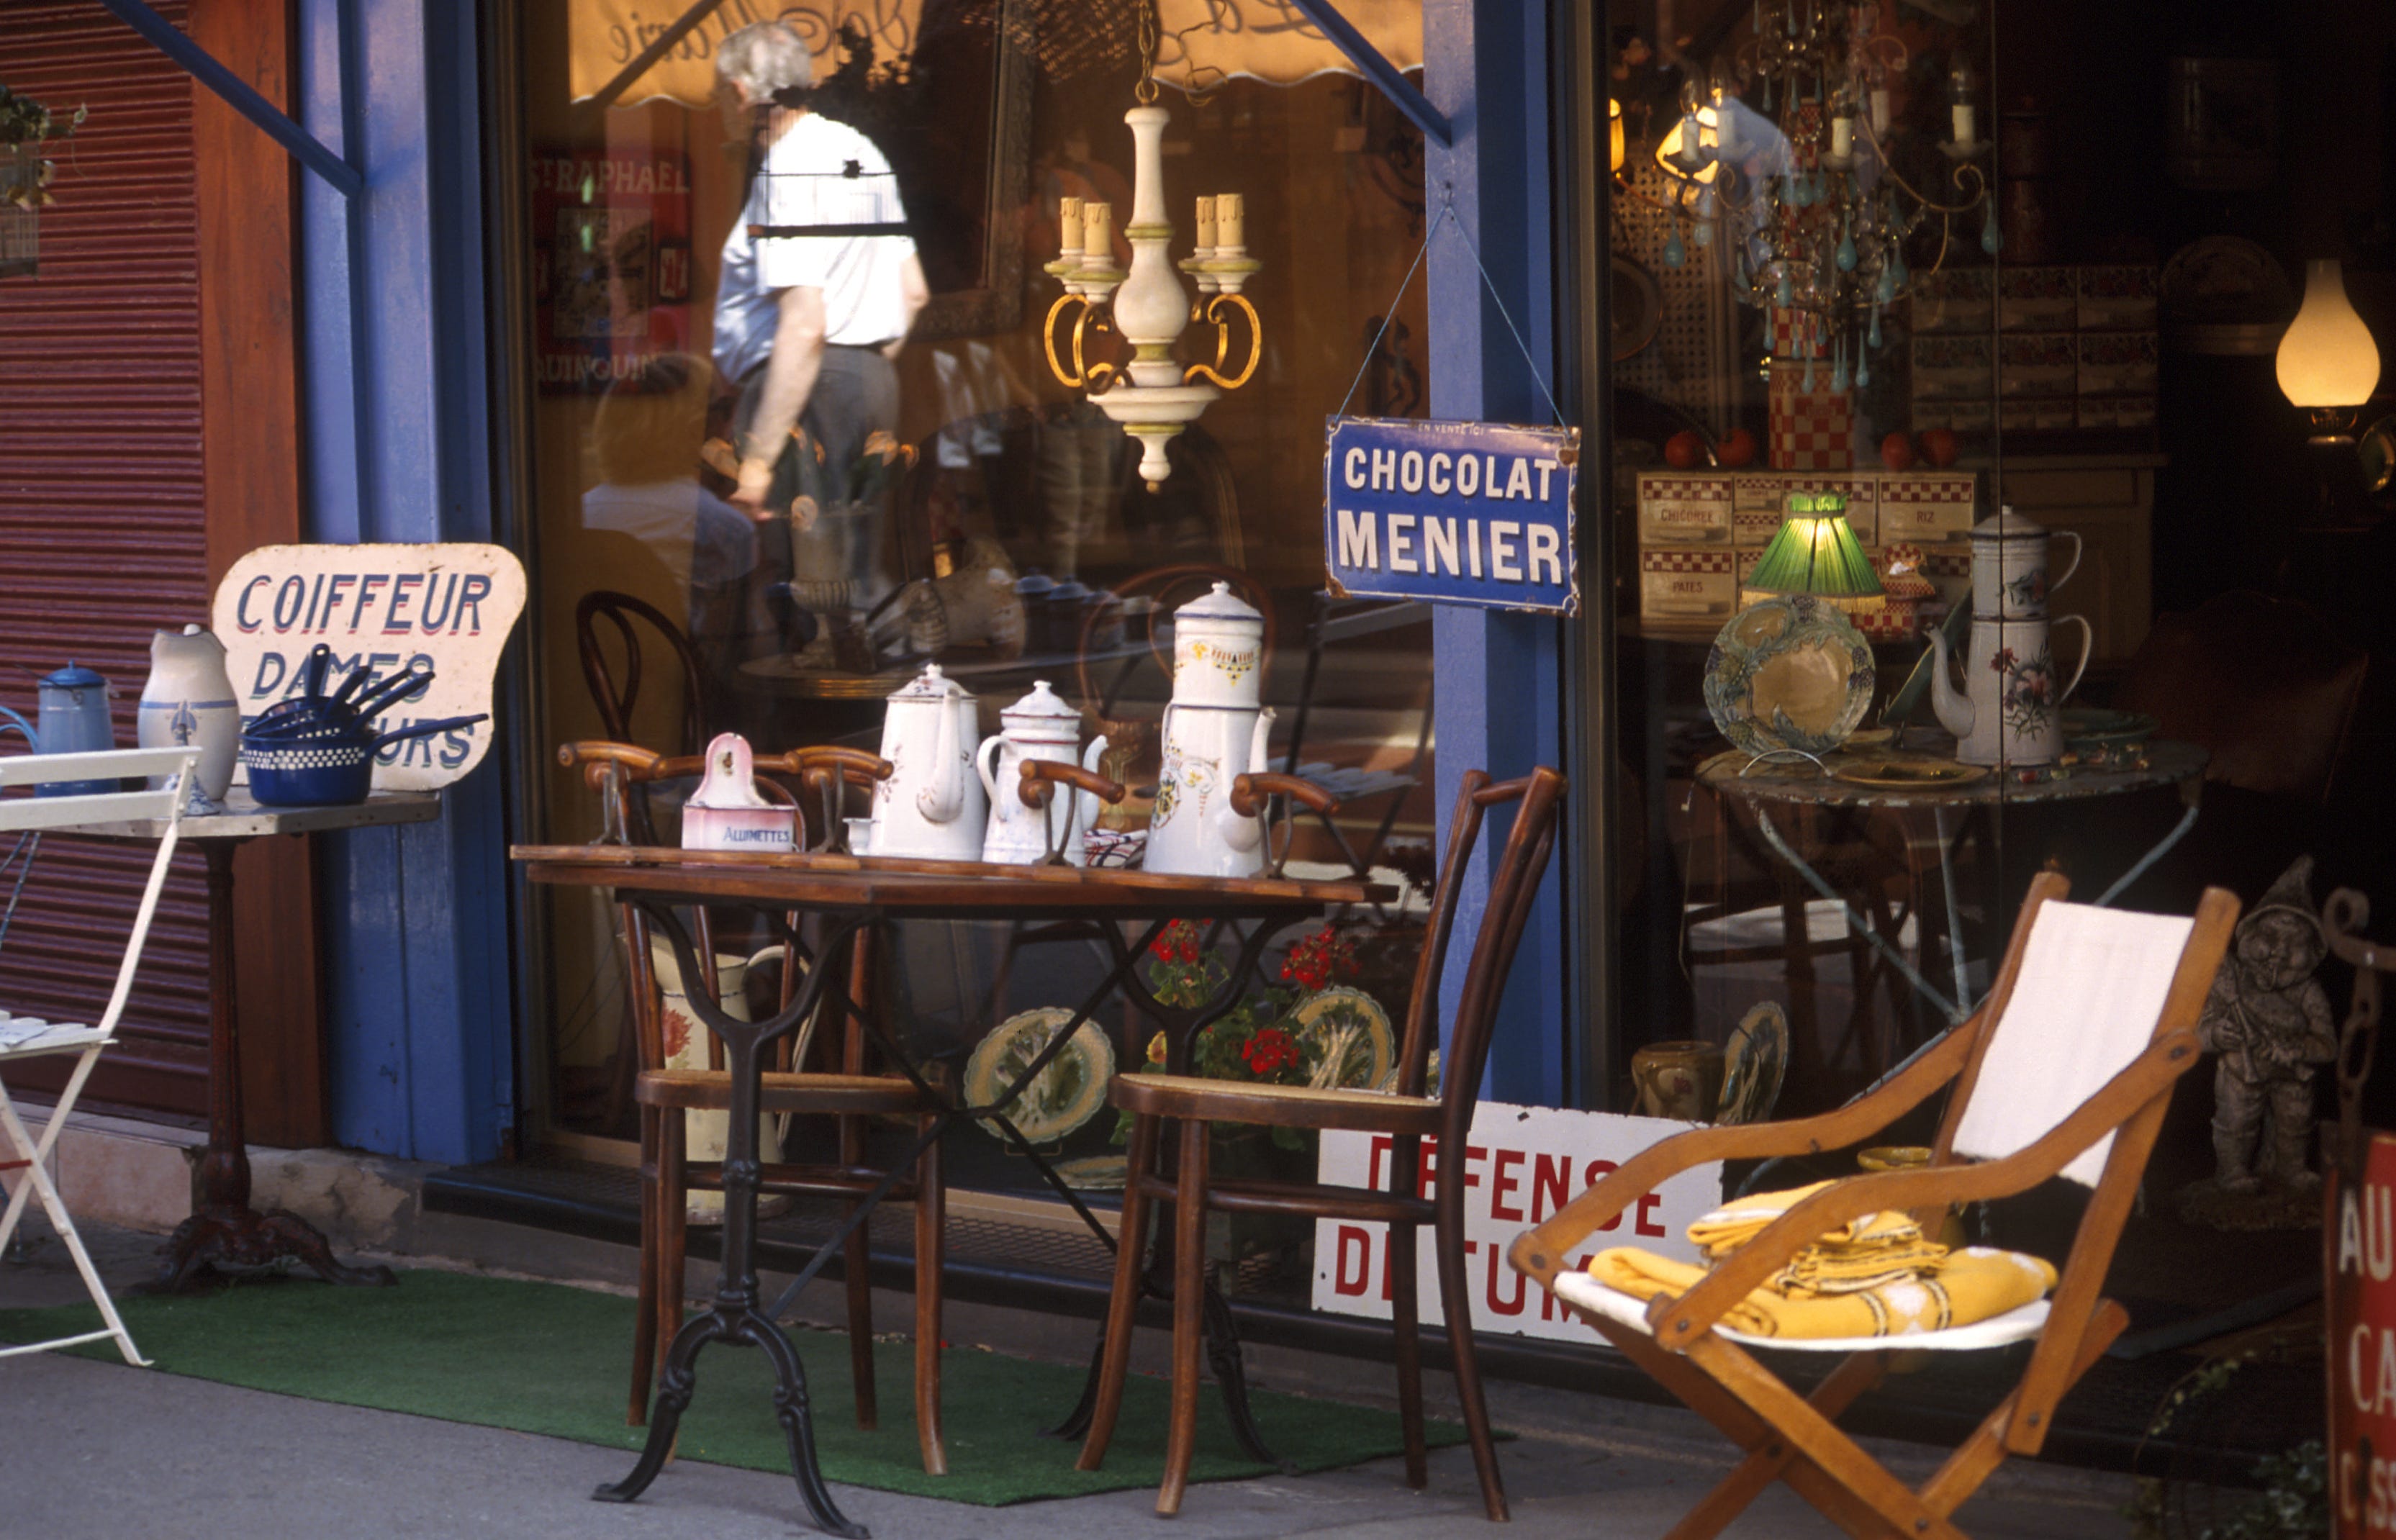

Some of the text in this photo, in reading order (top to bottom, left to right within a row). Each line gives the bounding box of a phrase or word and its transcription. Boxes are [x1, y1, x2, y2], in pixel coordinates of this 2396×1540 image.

[1344, 446, 1558, 502] CHOCOLAT
[1337, 509, 1563, 585] MENIER
[1917, 510, 1935, 523] RIZ
[236, 573, 492, 637] COIFFEUR
[1334, 1224, 1393, 1301] D
